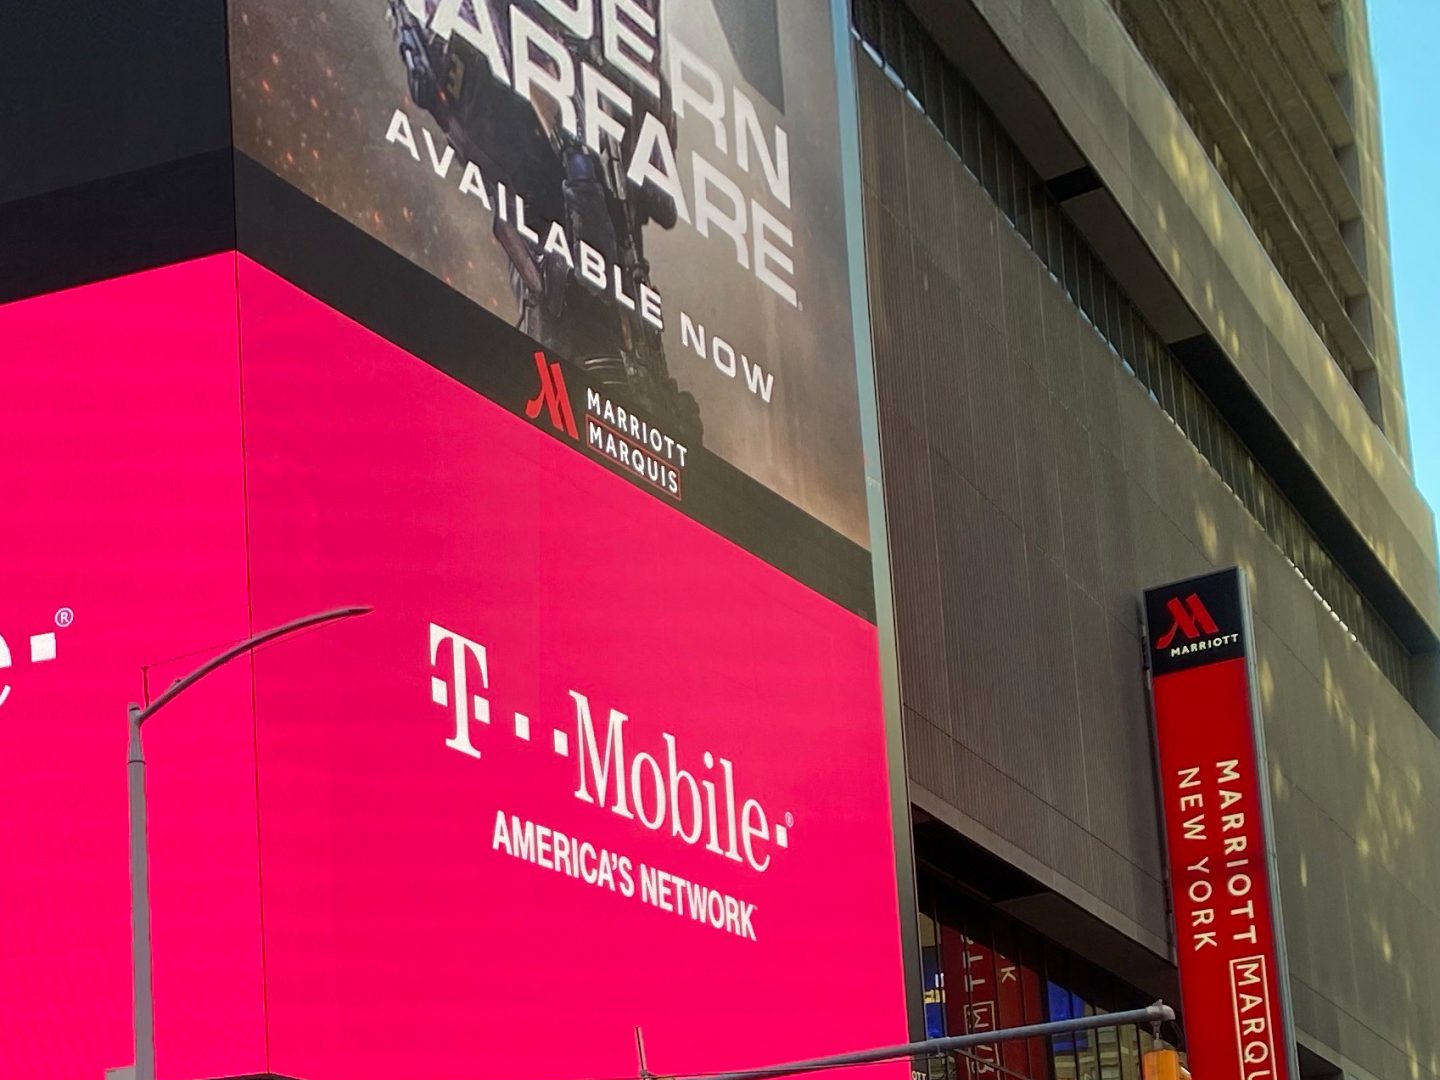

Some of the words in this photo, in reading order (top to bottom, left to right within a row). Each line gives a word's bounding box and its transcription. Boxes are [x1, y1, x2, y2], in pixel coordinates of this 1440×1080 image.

[406, 0, 798, 308] ARFARE
[386, 109, 663, 328] AVAILABLE
[680, 313, 774, 404] NOW
[587, 387, 687, 467] MARRIOTT
[588, 421, 679, 494] MARQUIS
[1171, 633, 1239, 657] MARRIOTT
[1177, 767, 1208, 842] NEW
[1216, 759, 1257, 945] MARRIOTT
[493, 810, 635, 898] AMERICA'S
[640, 864, 757, 941] NETWORK
[1187, 856, 1219, 952] YORK
